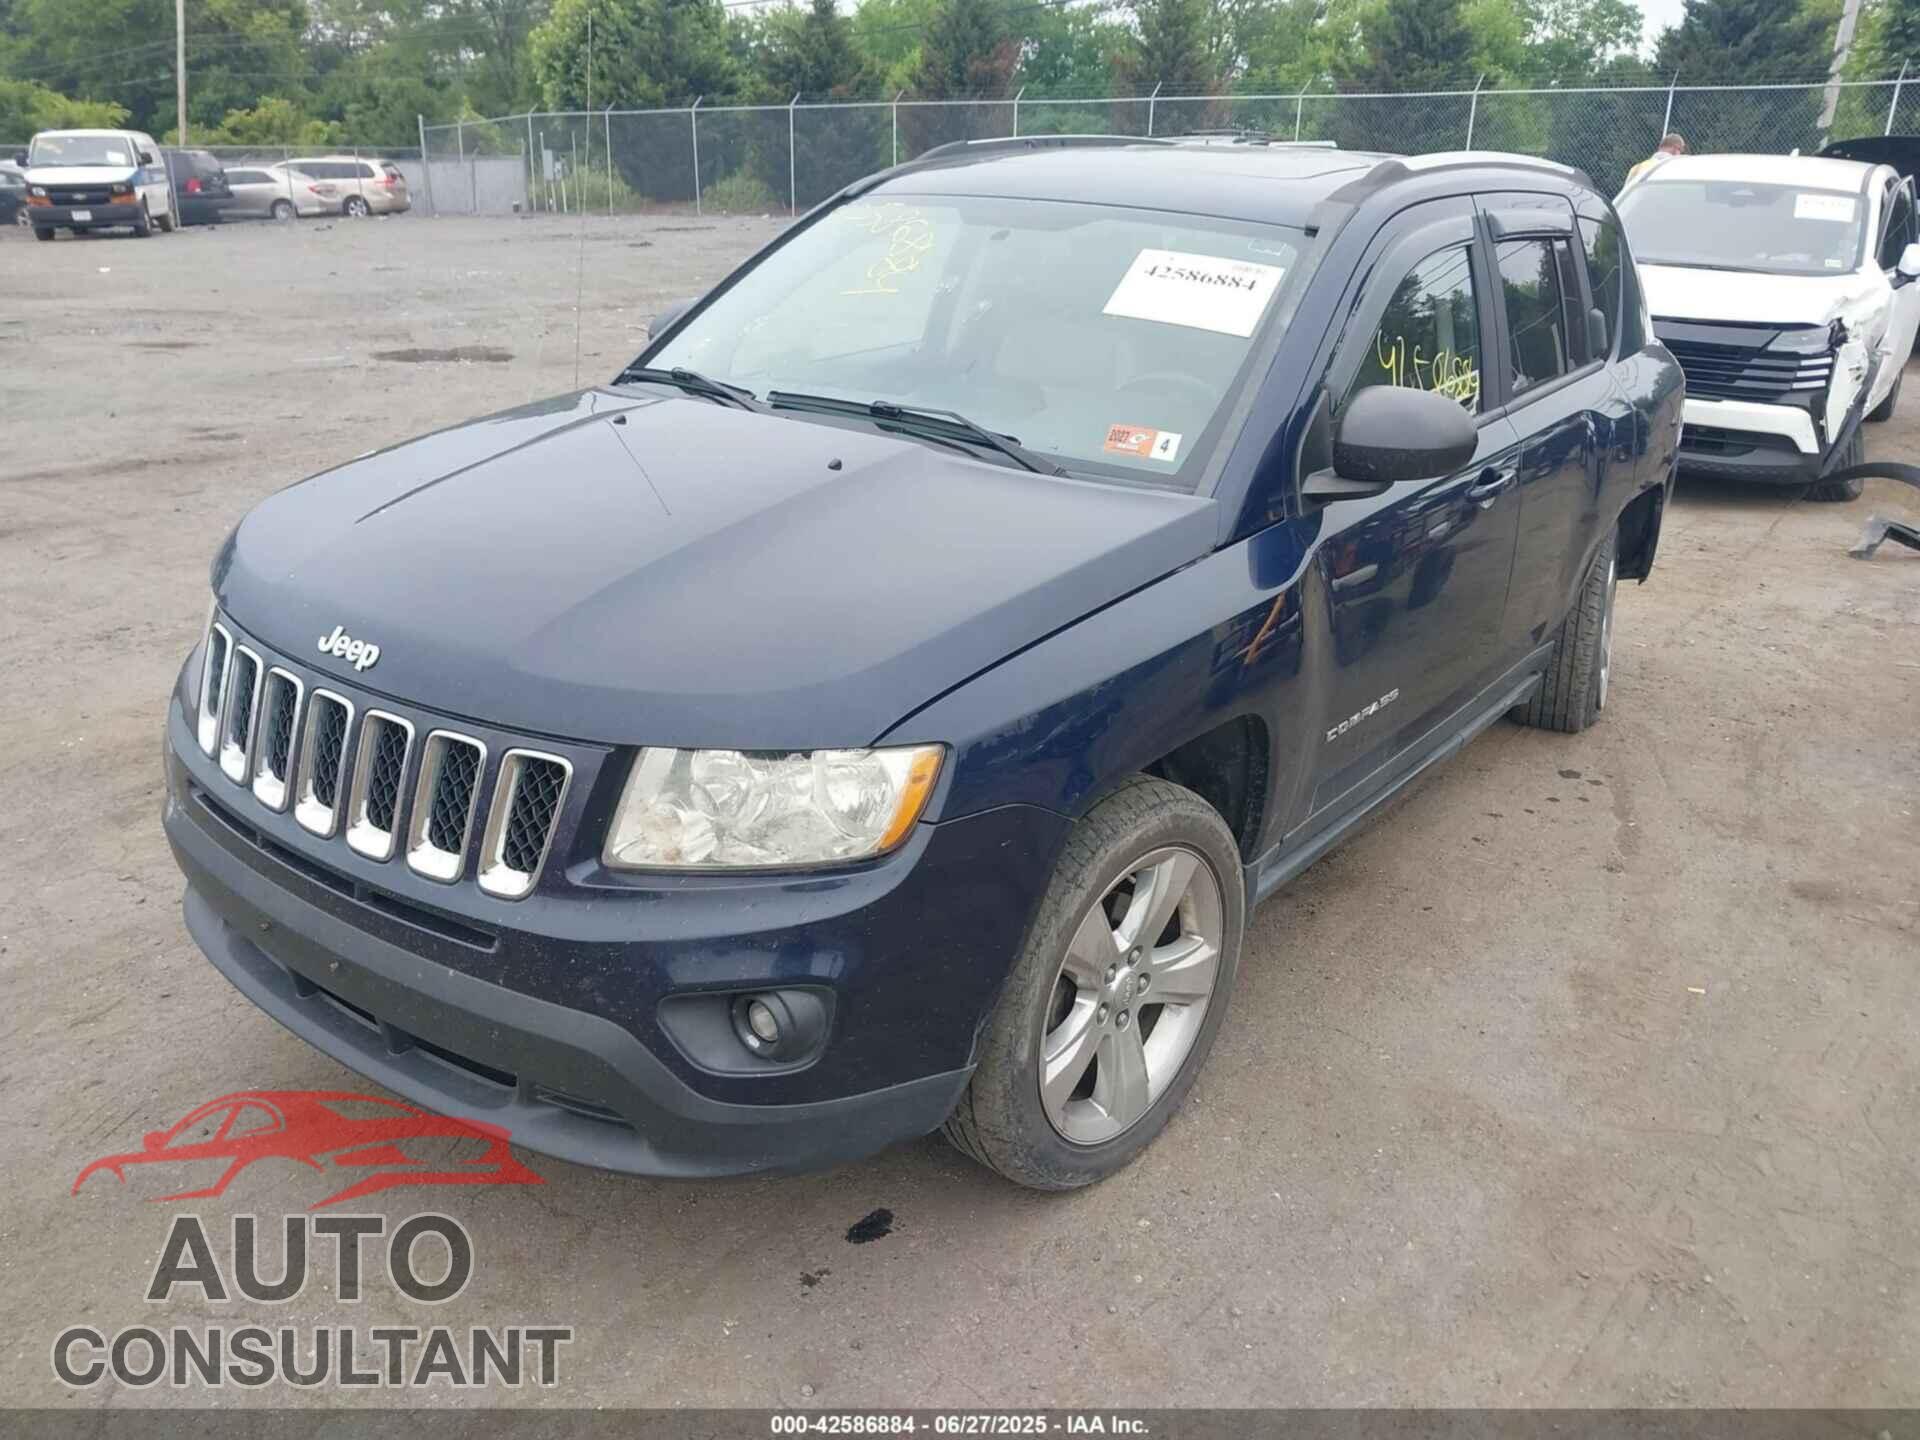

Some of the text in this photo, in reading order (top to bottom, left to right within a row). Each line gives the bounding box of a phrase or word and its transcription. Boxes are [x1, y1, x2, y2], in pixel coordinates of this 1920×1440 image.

[1143, 264, 1257, 292] 42586884
[1160, 438, 1170, 455] 4
[318, 625, 380, 672] Jeep
[1326, 687, 1400, 742] COMPASS
